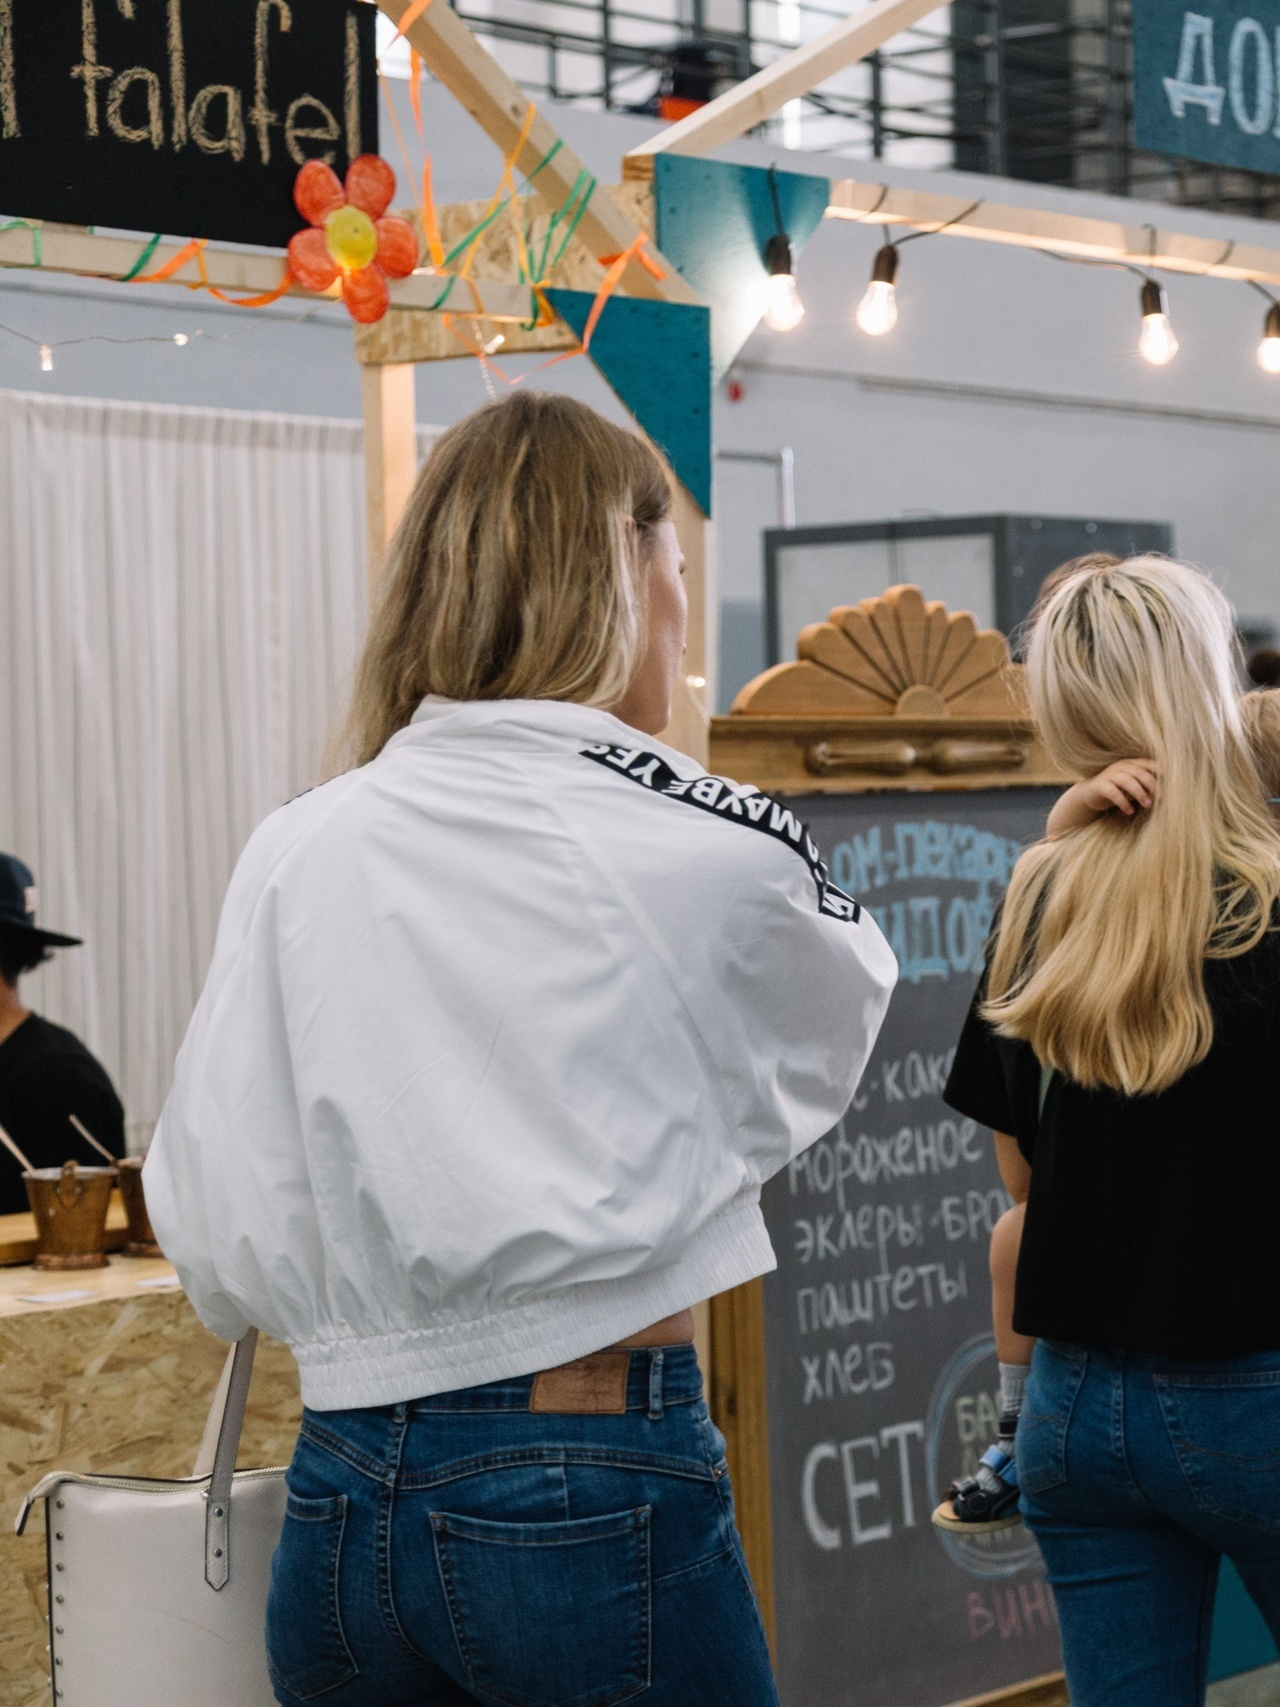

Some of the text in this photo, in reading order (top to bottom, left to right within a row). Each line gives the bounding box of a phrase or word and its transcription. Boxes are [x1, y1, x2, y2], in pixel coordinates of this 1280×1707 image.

[70, 0, 364, 166] falafel
[661, 777, 803, 843] MAYBE
[802, 1421, 924, 1549] СЕТ
